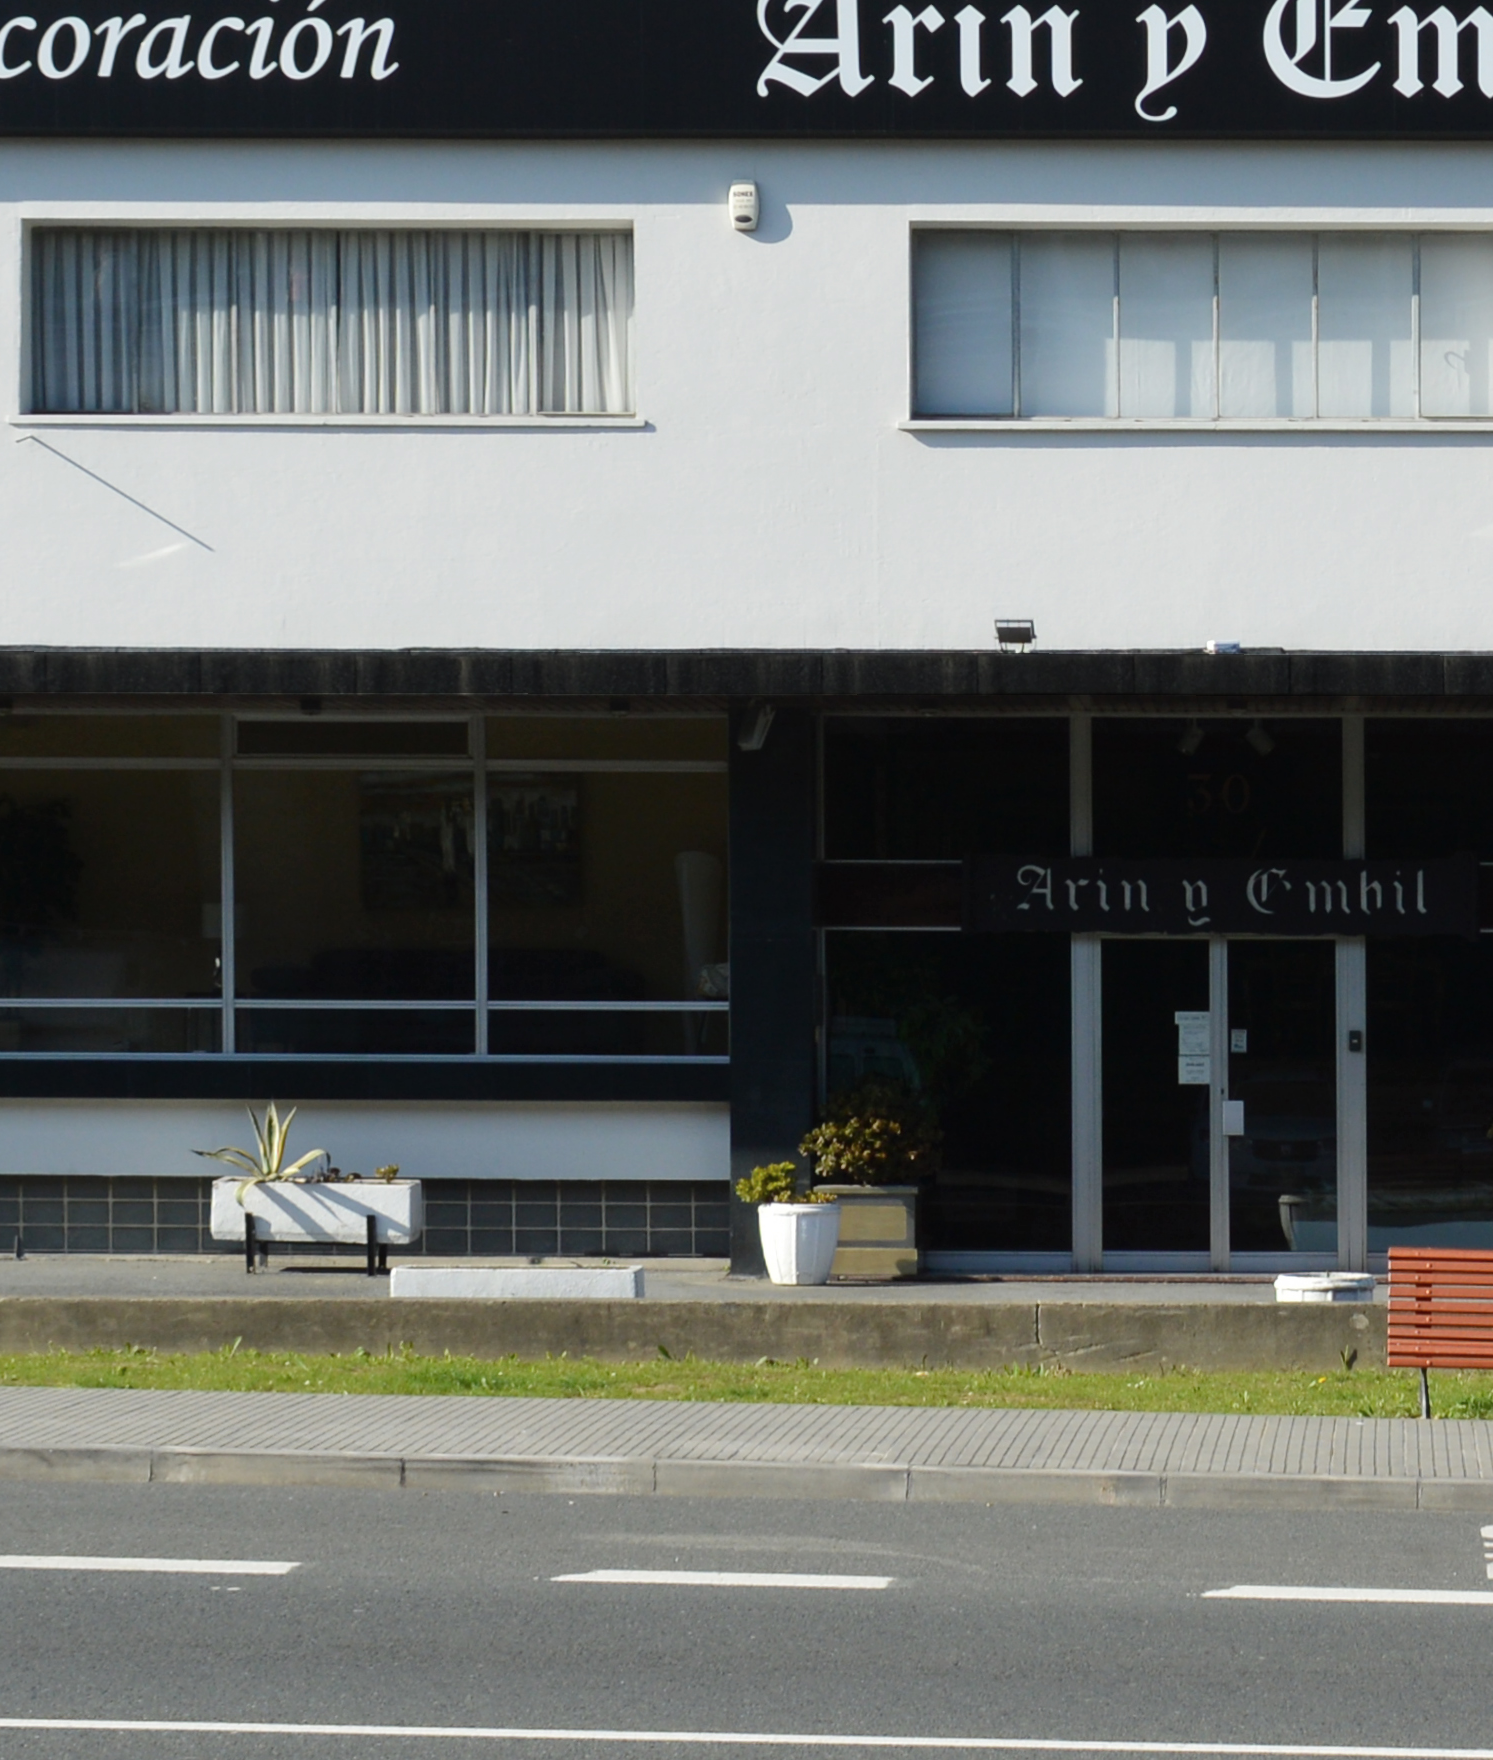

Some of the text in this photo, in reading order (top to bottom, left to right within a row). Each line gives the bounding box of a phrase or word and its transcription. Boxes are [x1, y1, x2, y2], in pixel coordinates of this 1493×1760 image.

[1134, 3, 1207, 122] y
[1182, 880, 1211, 927] y
[1246, 868, 1427, 914] Embil
